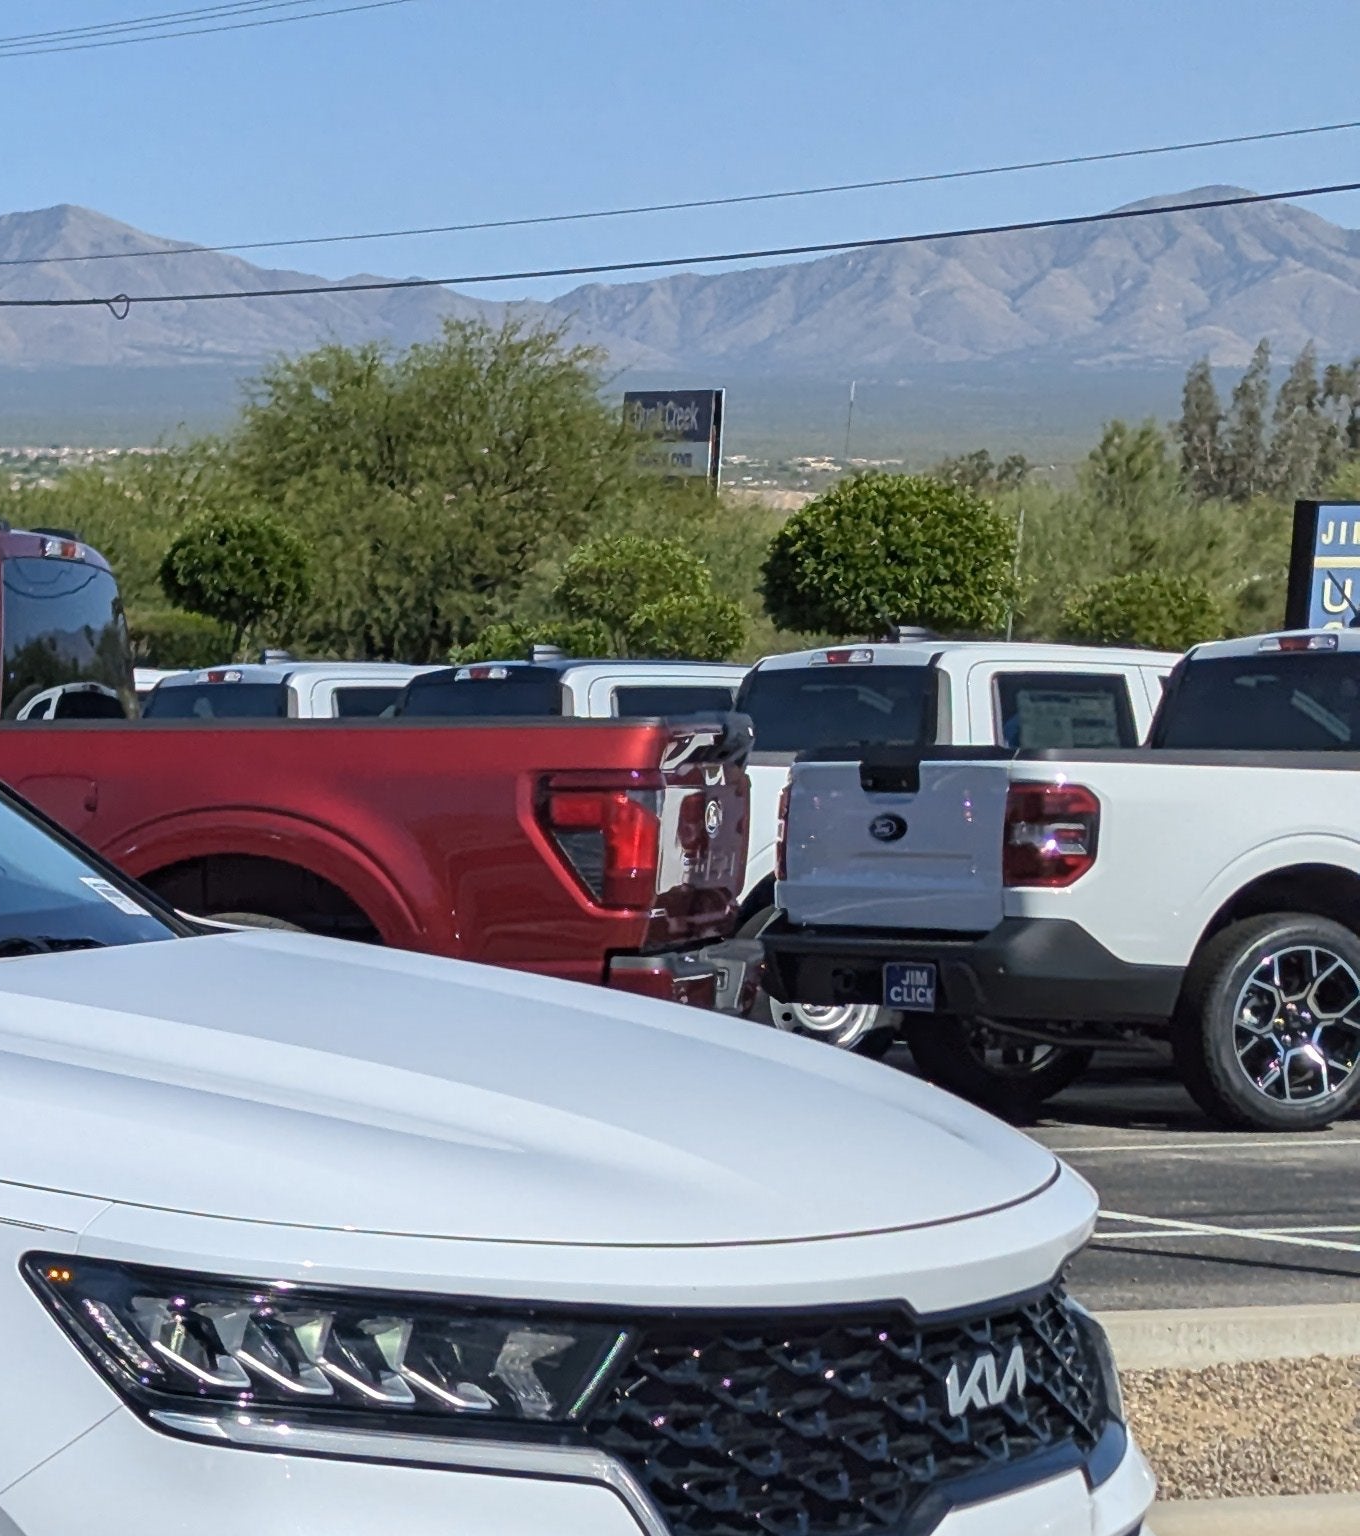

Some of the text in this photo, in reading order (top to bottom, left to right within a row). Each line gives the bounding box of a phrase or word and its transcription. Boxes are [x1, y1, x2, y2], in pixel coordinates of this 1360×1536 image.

[901, 969, 928, 985] JIM
[890, 986, 934, 1003] CLICK
[946, 1345, 1027, 1417] KIA
